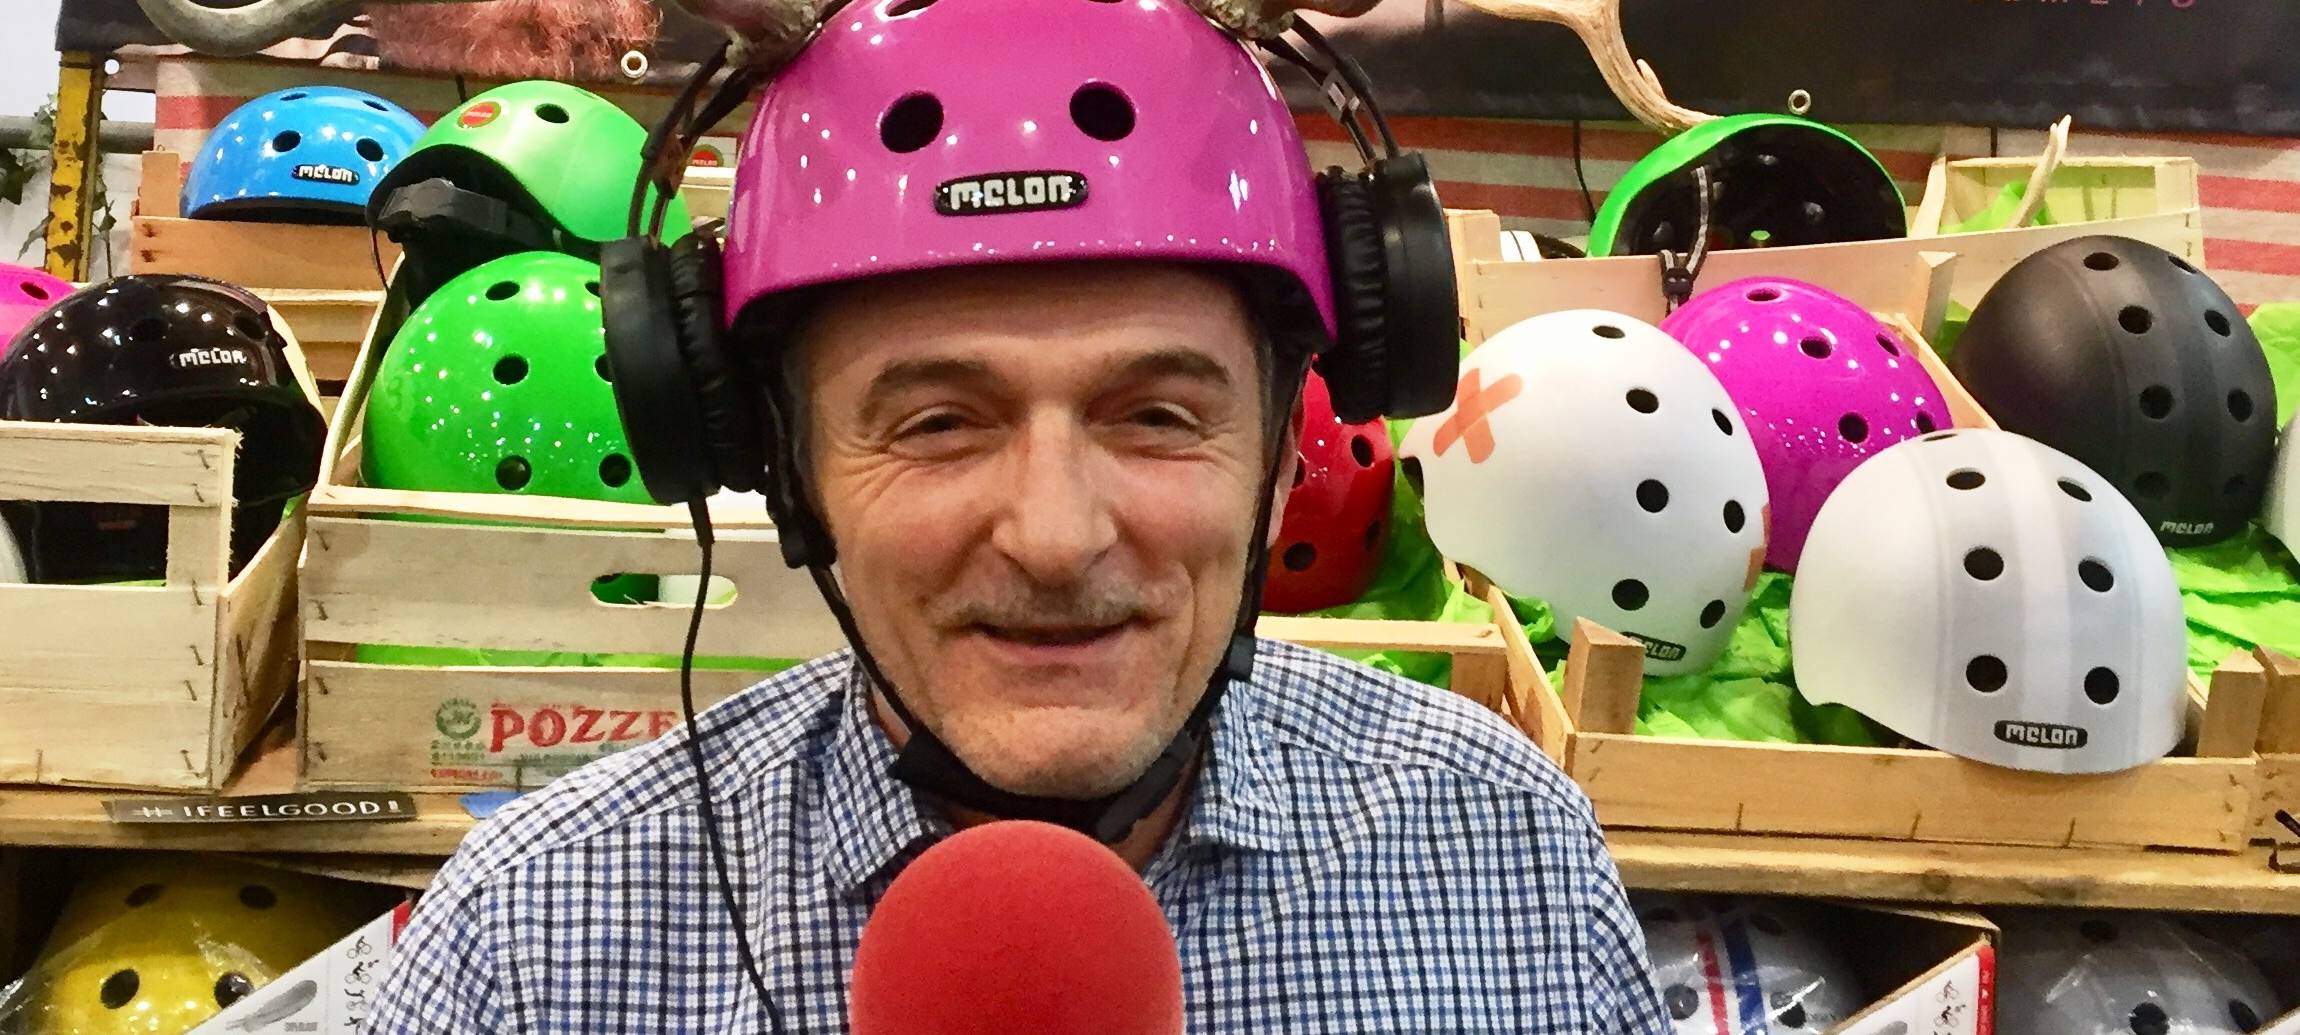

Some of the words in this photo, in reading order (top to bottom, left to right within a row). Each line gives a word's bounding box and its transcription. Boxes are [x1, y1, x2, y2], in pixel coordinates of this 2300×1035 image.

[298, 165, 353, 182] MELON
[950, 175, 1073, 210] MELON
[179, 349, 245, 367] MELON
[2006, 724, 2078, 745] MELON
